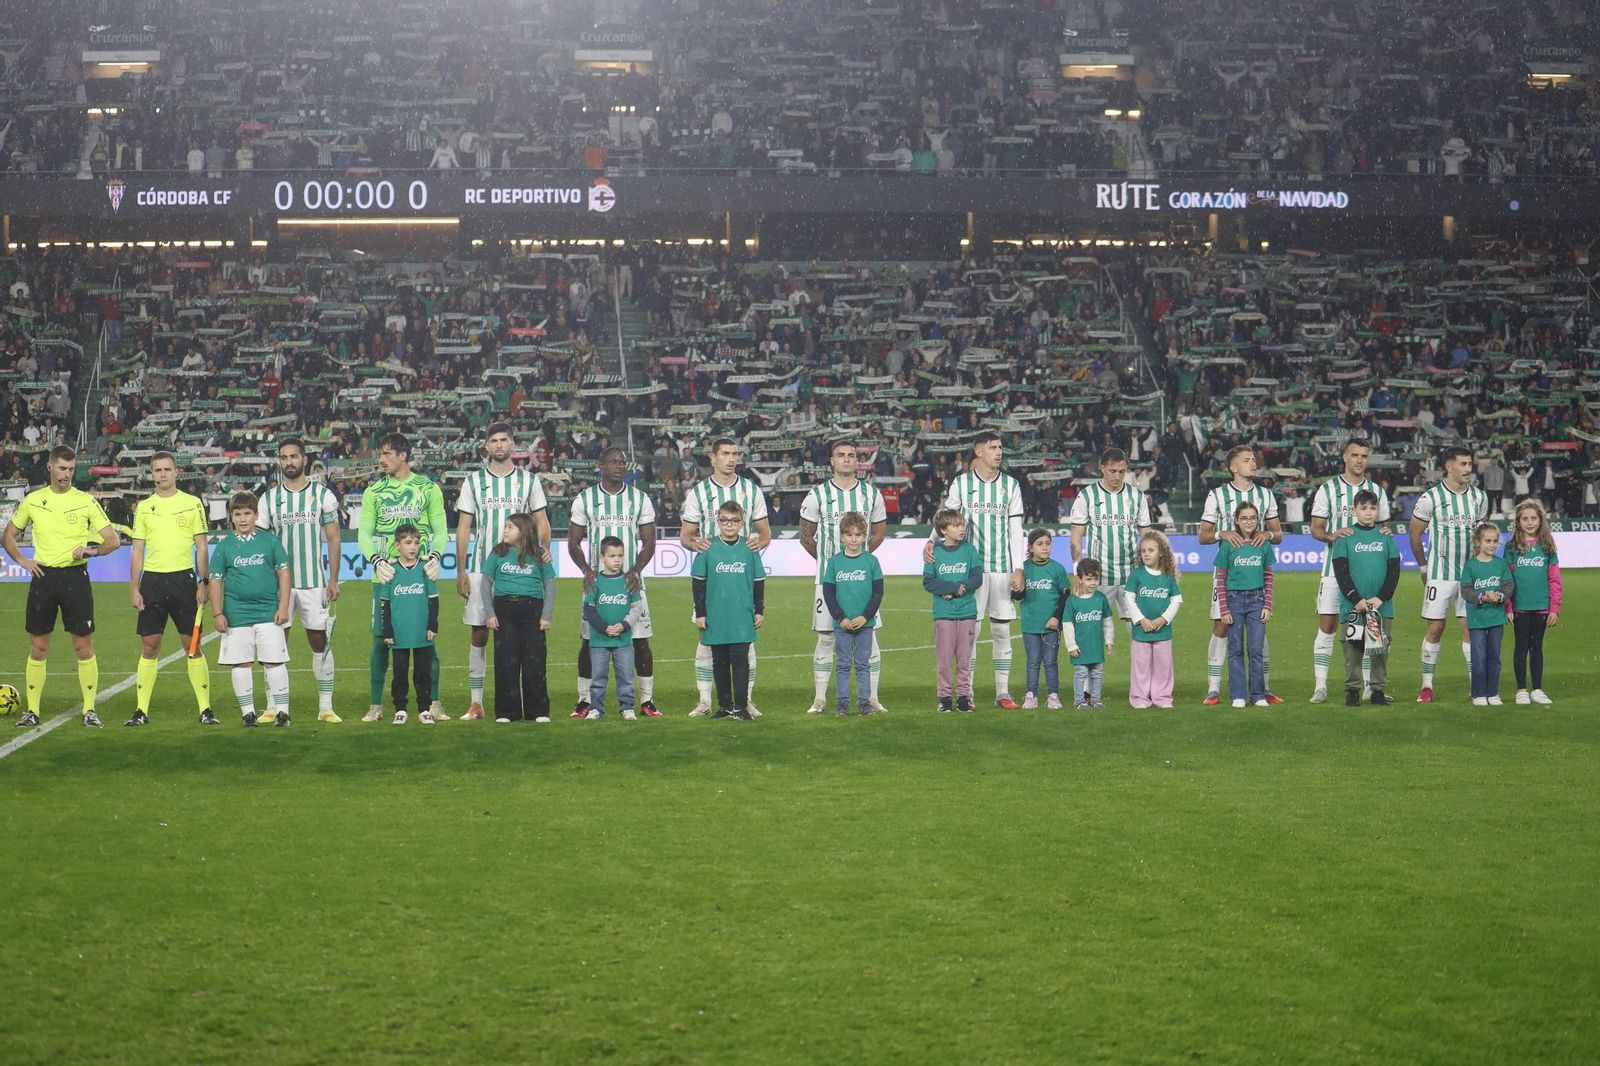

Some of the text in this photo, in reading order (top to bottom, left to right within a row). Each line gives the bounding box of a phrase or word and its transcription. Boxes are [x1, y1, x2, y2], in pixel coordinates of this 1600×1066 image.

[90, 32, 154, 44] Cruzcampo
[581, 31, 645, 44] Cruzcampo
[137, 187, 232, 206] CÓRDOBA CF
[274, 180, 428, 211] 0 00:00 0
[465, 188, 582, 204] RC DEPORTIVO
[1096, 181, 1160, 211] RUTE
[1168, 187, 1247, 209] CORAZÓN
[1256, 190, 1265, 198] DE
[1279, 190, 1349, 209] NAVIDAD
[382, 506, 422, 514] BAHRAIN
[967, 502, 1007, 510] BAHRAIN
[276, 511, 317, 521] BAHRAIN
[1095, 513, 1134, 521] BAHRAIN
[1426, 586, 1437, 601] 10
